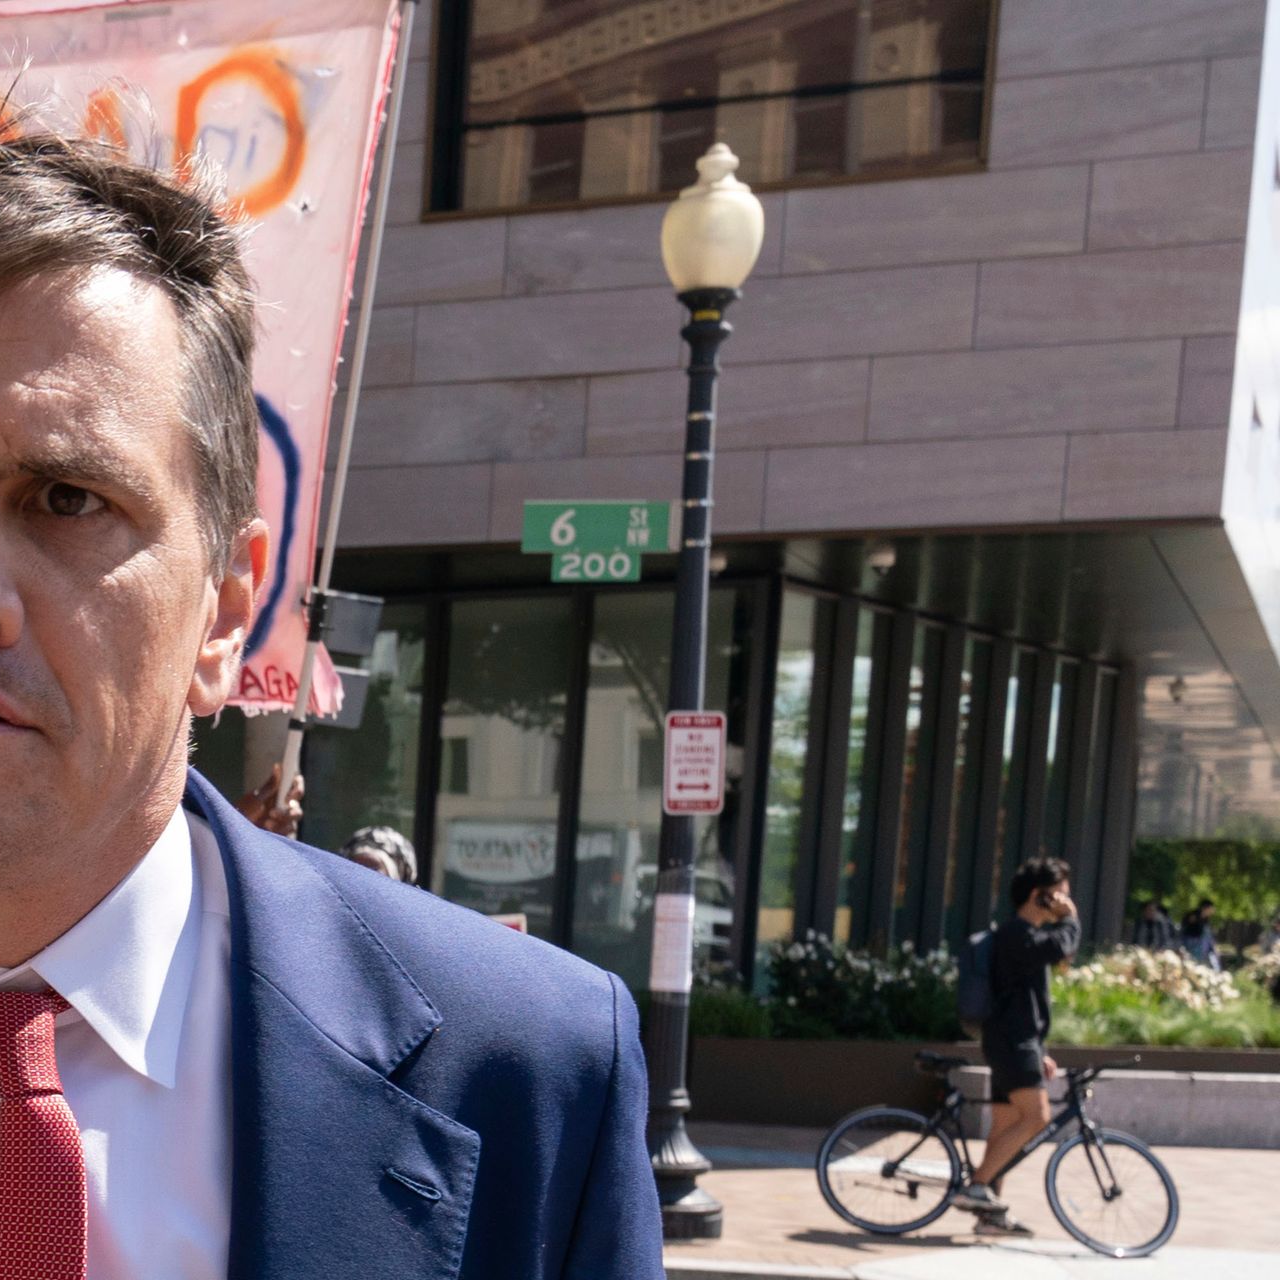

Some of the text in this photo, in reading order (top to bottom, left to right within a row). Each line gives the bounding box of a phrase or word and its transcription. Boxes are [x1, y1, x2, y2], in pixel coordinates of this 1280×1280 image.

[550, 507, 649, 547] 6 St
[626, 527, 651, 547] NW
[559, 552, 632, 579] 200
